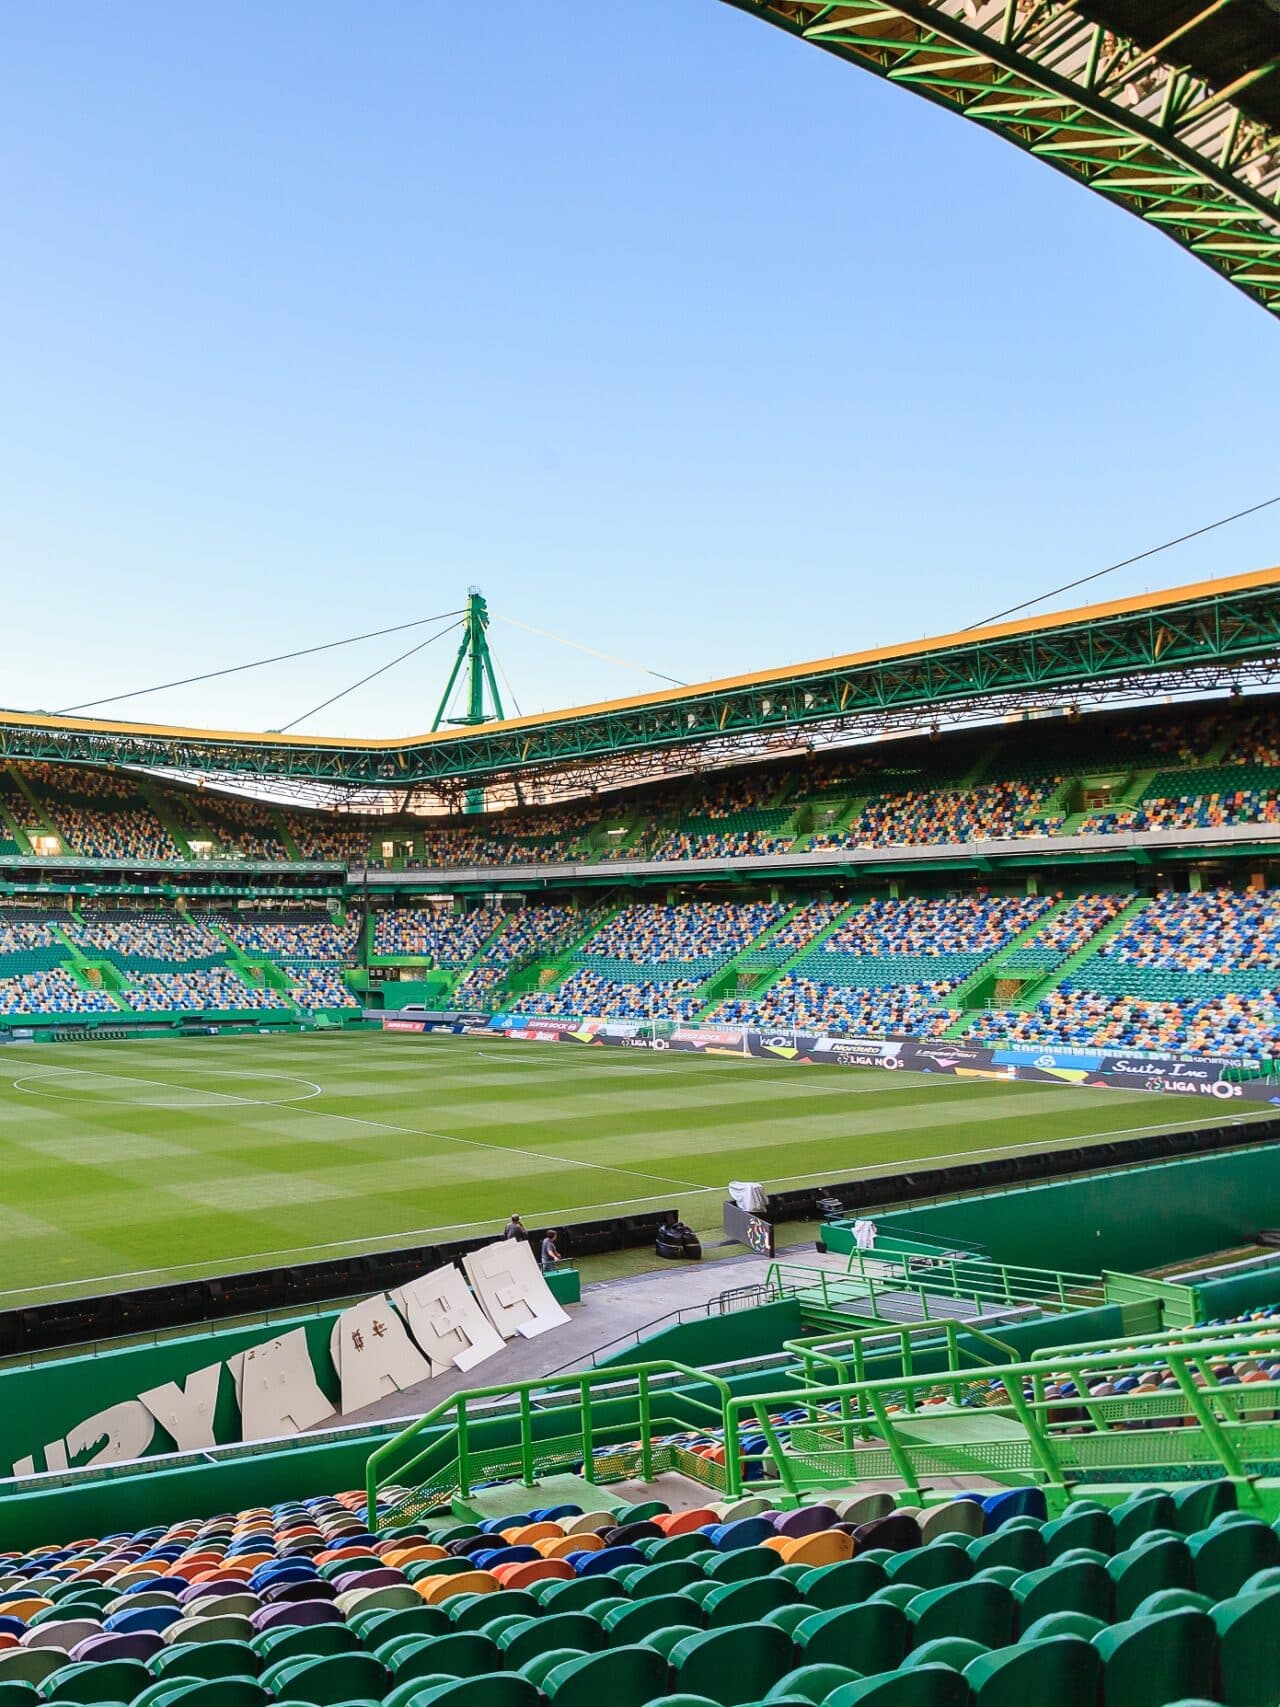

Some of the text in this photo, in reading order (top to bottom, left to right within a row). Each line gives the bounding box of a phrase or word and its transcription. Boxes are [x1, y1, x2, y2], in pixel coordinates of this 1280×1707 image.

[528, 1020, 548, 1028] SUPER
[631, 1040, 647, 1048] LIGA
[851, 1055, 904, 1070] LIGA NOS
[1168, 1063, 1208, 1078] Inc
[1165, 1080, 1243, 1099] LIGA NOS
